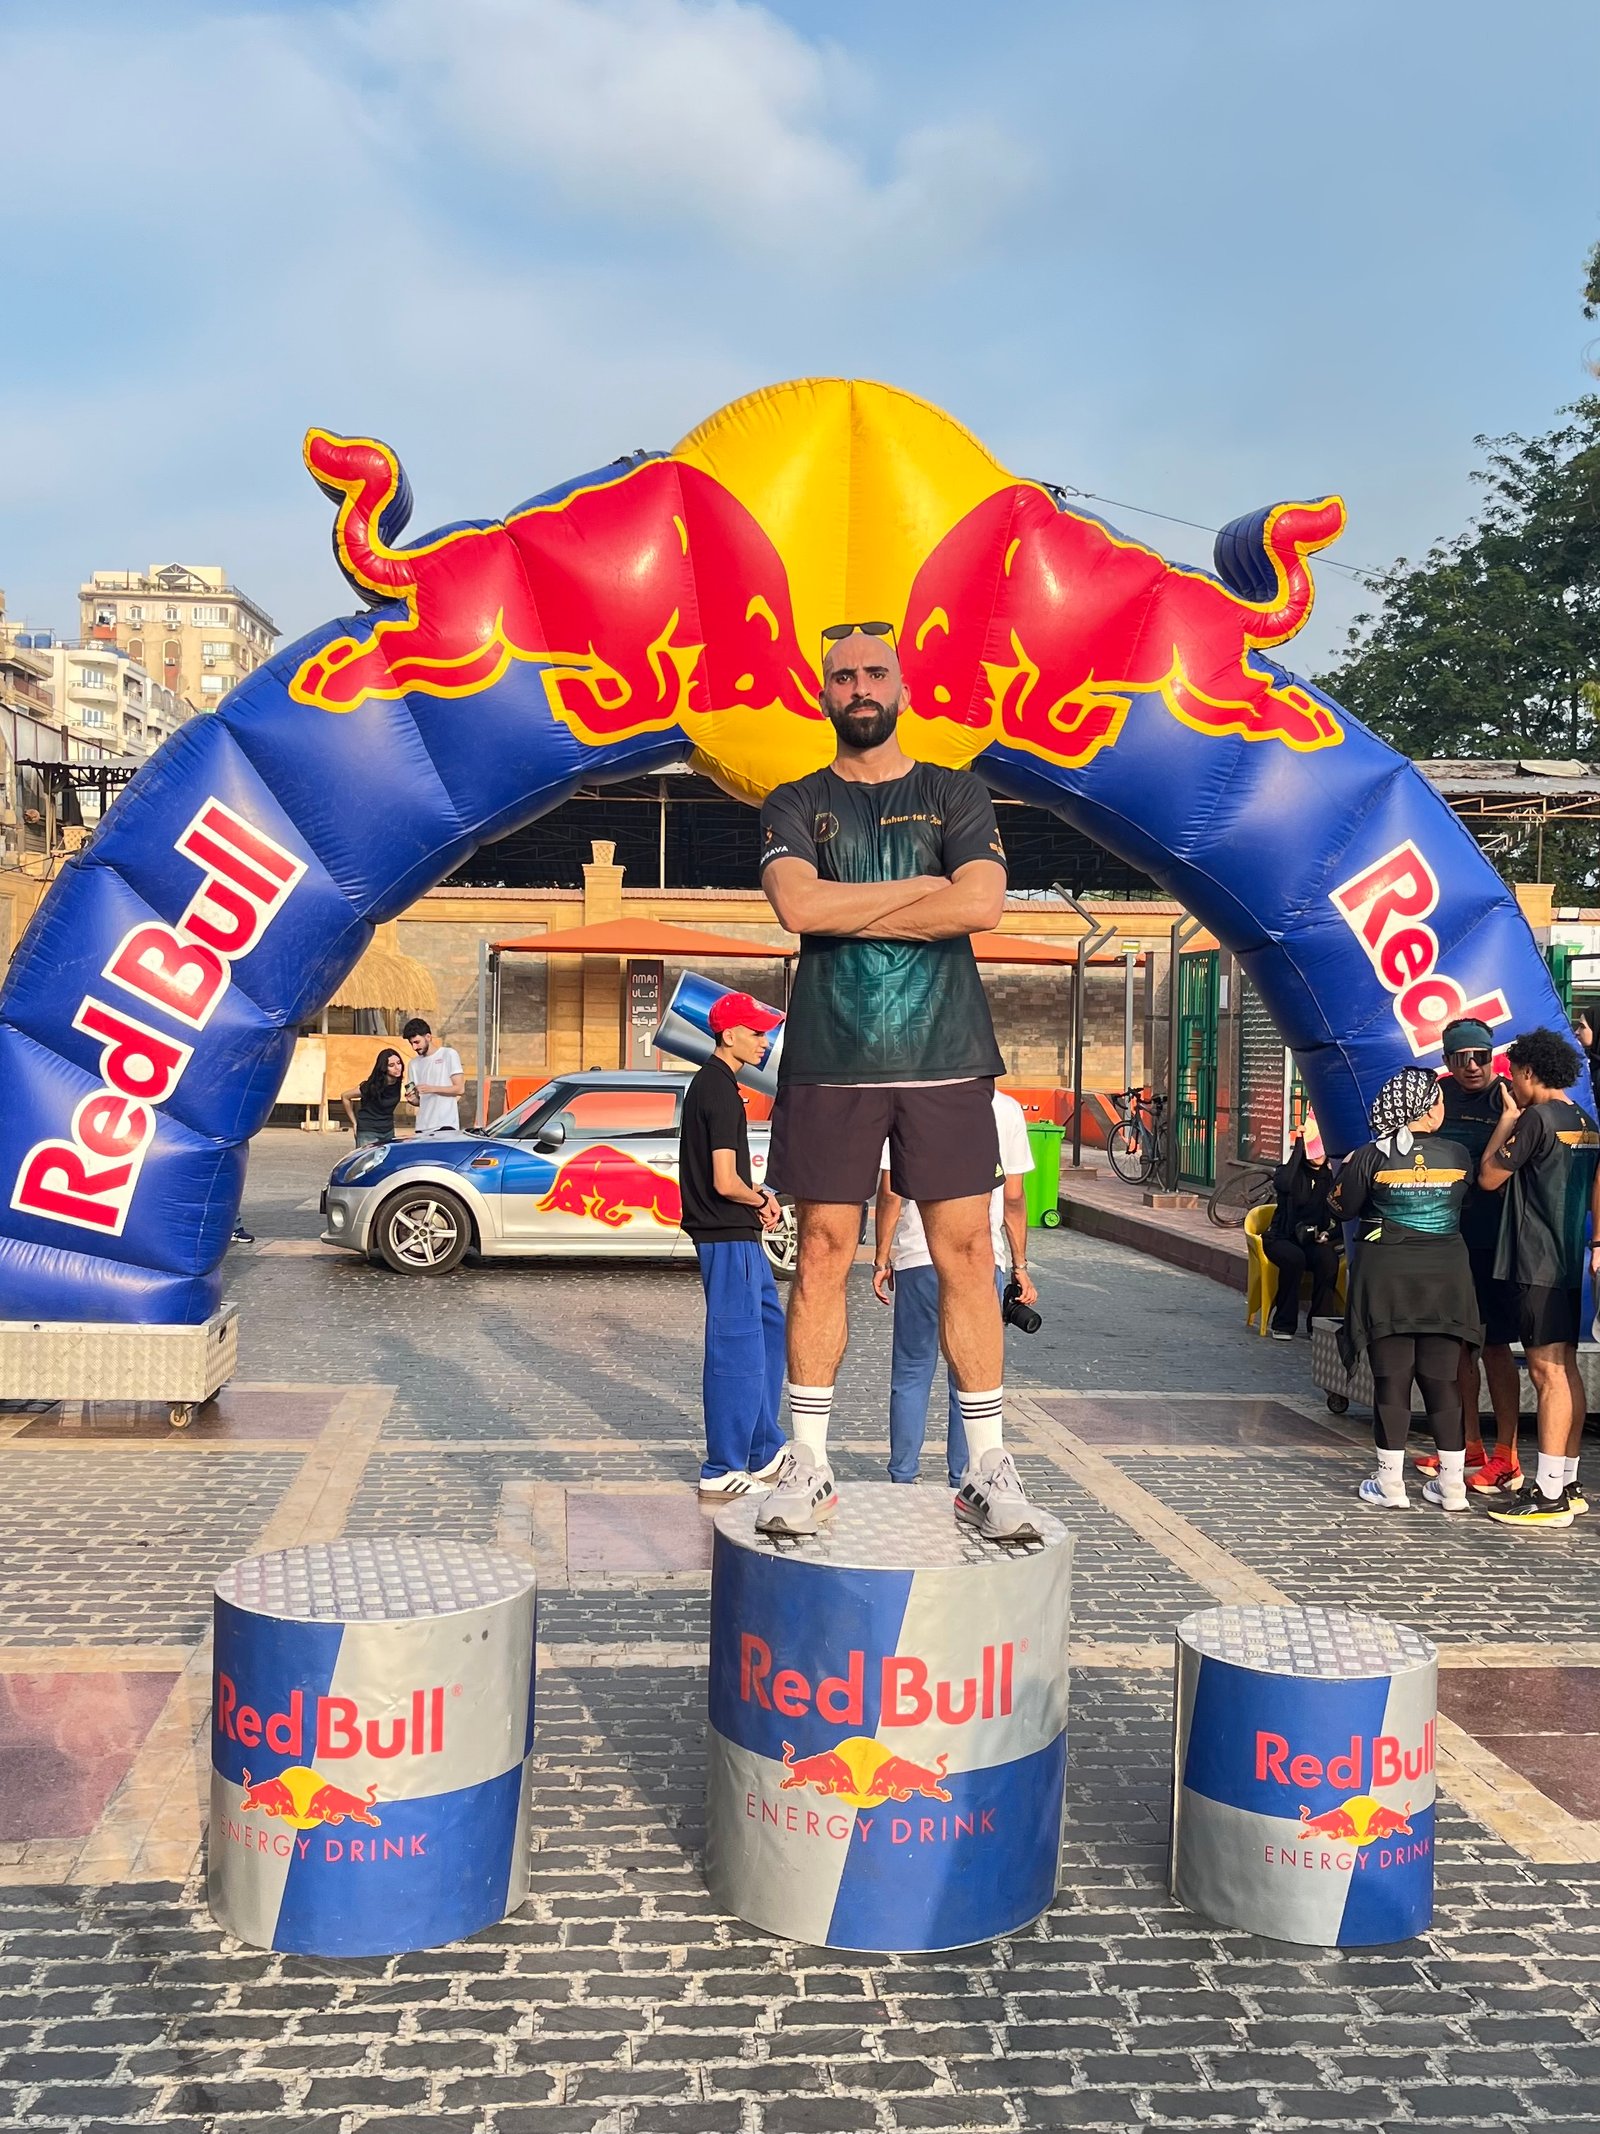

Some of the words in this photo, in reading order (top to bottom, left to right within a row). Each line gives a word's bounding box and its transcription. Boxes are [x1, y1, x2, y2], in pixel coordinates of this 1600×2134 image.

[1336, 846, 1506, 1050] Red
[18, 1003, 186, 1230] Red
[110, 804, 299, 1023] Bull
[638, 1031, 652, 1057] 1
[216, 1671, 304, 1757] Red
[315, 1686, 445, 1760] Bull
[739, 1631, 865, 1727] Red
[879, 1641, 1015, 1728] Bull
[1254, 1730, 1363, 1789] Red
[1371, 1716, 1435, 1788] Bull
[219, 1814, 312, 1861] ENERGY
[324, 1833, 429, 1863] DRINK
[746, 1792, 874, 1843] ENERGY
[890, 1808, 996, 1845] DRINK
[1264, 1845, 1370, 1871] ENERGY
[1379, 1838, 1431, 1868] DRINK
